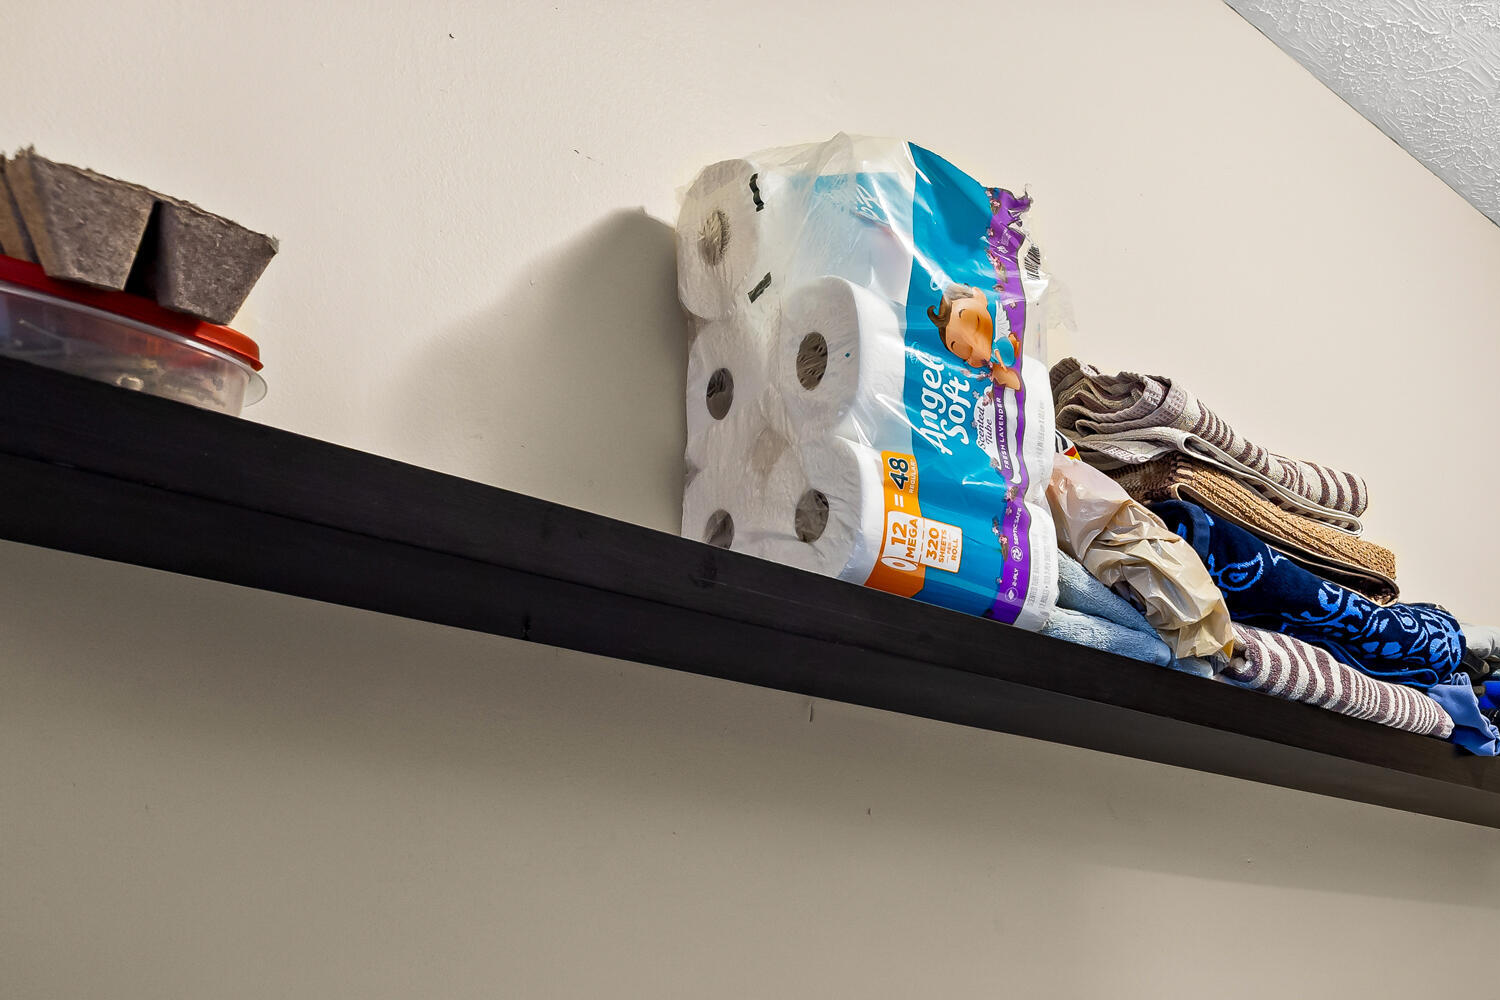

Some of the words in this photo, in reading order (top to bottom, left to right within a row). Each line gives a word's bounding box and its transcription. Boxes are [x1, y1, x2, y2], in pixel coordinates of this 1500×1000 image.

[916, 350, 953, 456] Angel
[941, 376, 971, 445] Soft
[995, 396, 1005, 444] LAVENDER
[977, 405, 986, 450] Scented
[889, 457, 910, 490] 48
[999, 445, 1010, 470] FRESH
[891, 522, 908, 546] 12
[905, 518, 919, 559] MEGA
[926, 527, 940, 561] 320
[938, 529, 947, 563] SHEETS
[950, 538, 959, 561] ROLL
